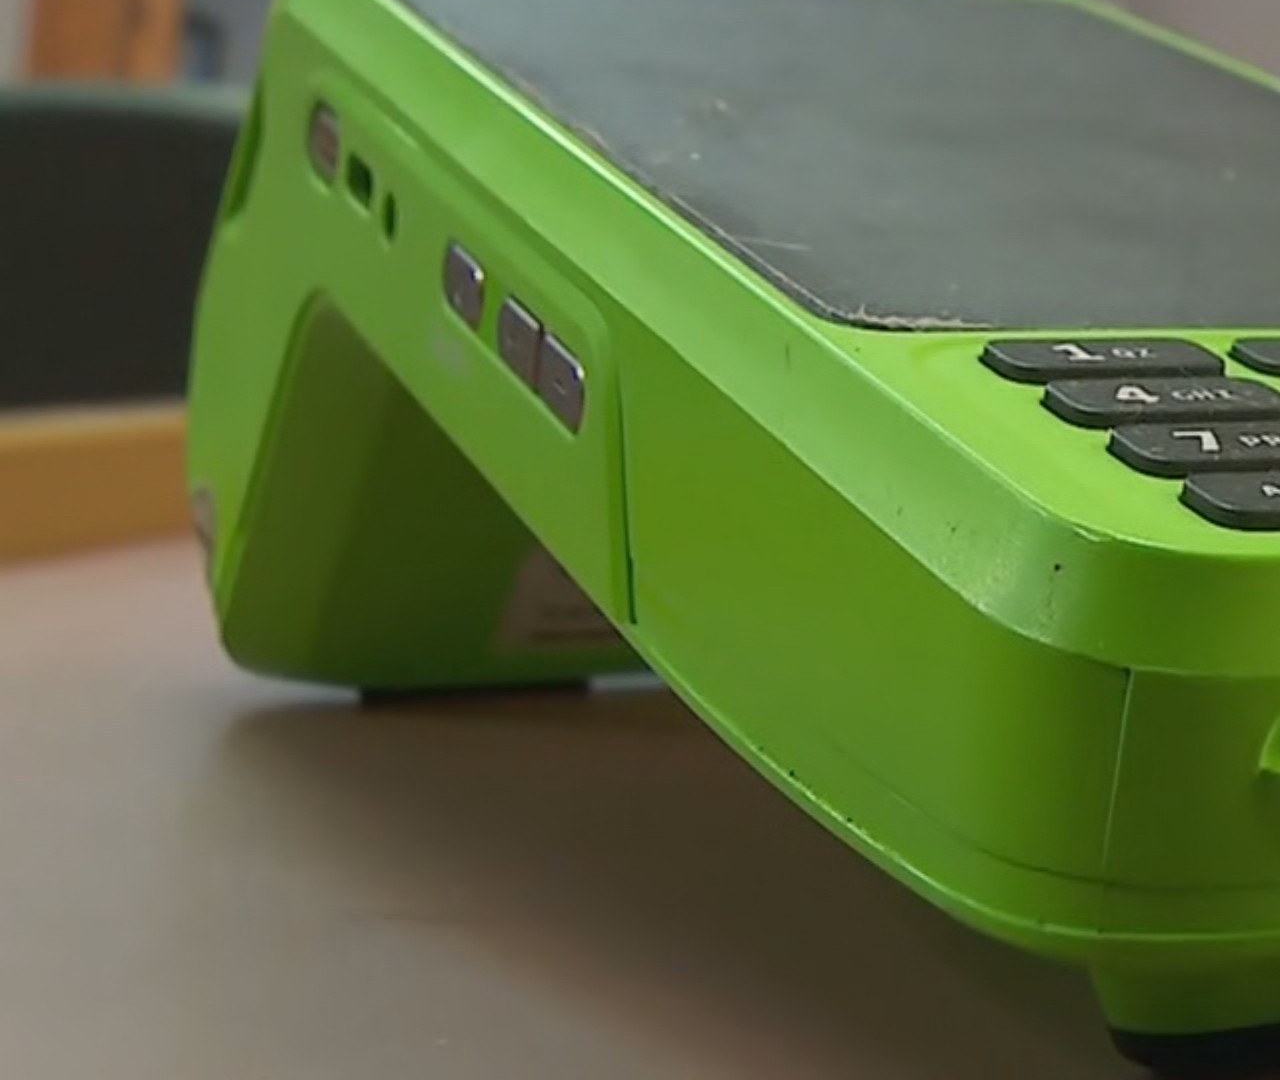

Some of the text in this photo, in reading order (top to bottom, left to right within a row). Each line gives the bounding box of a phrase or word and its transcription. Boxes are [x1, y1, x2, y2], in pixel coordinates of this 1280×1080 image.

[1052, 342, 1106, 361] 1
[1115, 385, 1160, 404] 4
[1172, 430, 1221, 452] 7
